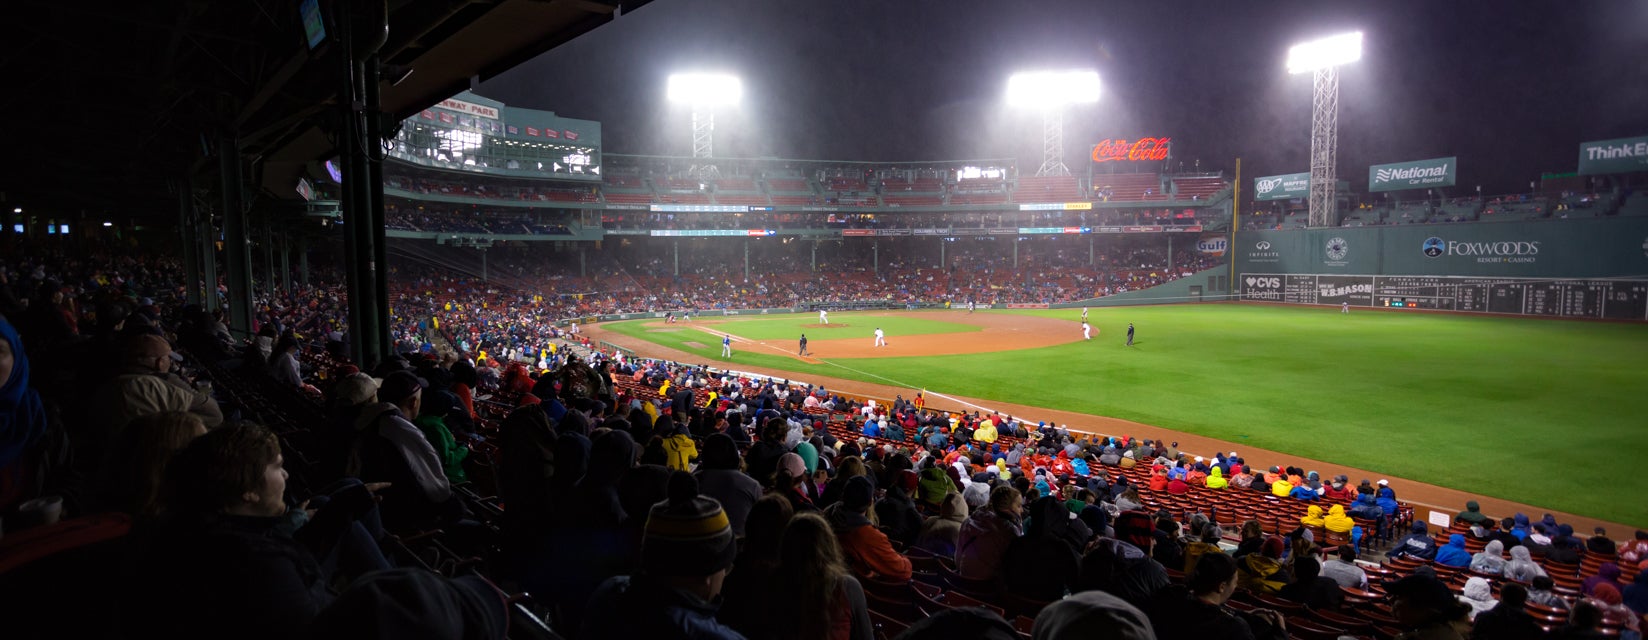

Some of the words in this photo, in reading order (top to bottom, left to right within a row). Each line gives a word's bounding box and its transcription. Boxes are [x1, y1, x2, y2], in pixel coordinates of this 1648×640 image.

[438, 100, 466, 111] NWAY
[471, 105, 495, 117] PARK
[1092, 137, 1171, 162] Coca-Cola
[1390, 163, 1448, 180] National
[1421, 176, 1444, 184] Rental
[1198, 240, 1226, 250] Gulf
[1448, 241, 1539, 255] FOXWOODS
[1256, 277, 1281, 288] CVS
[1246, 288, 1281, 300] Health
